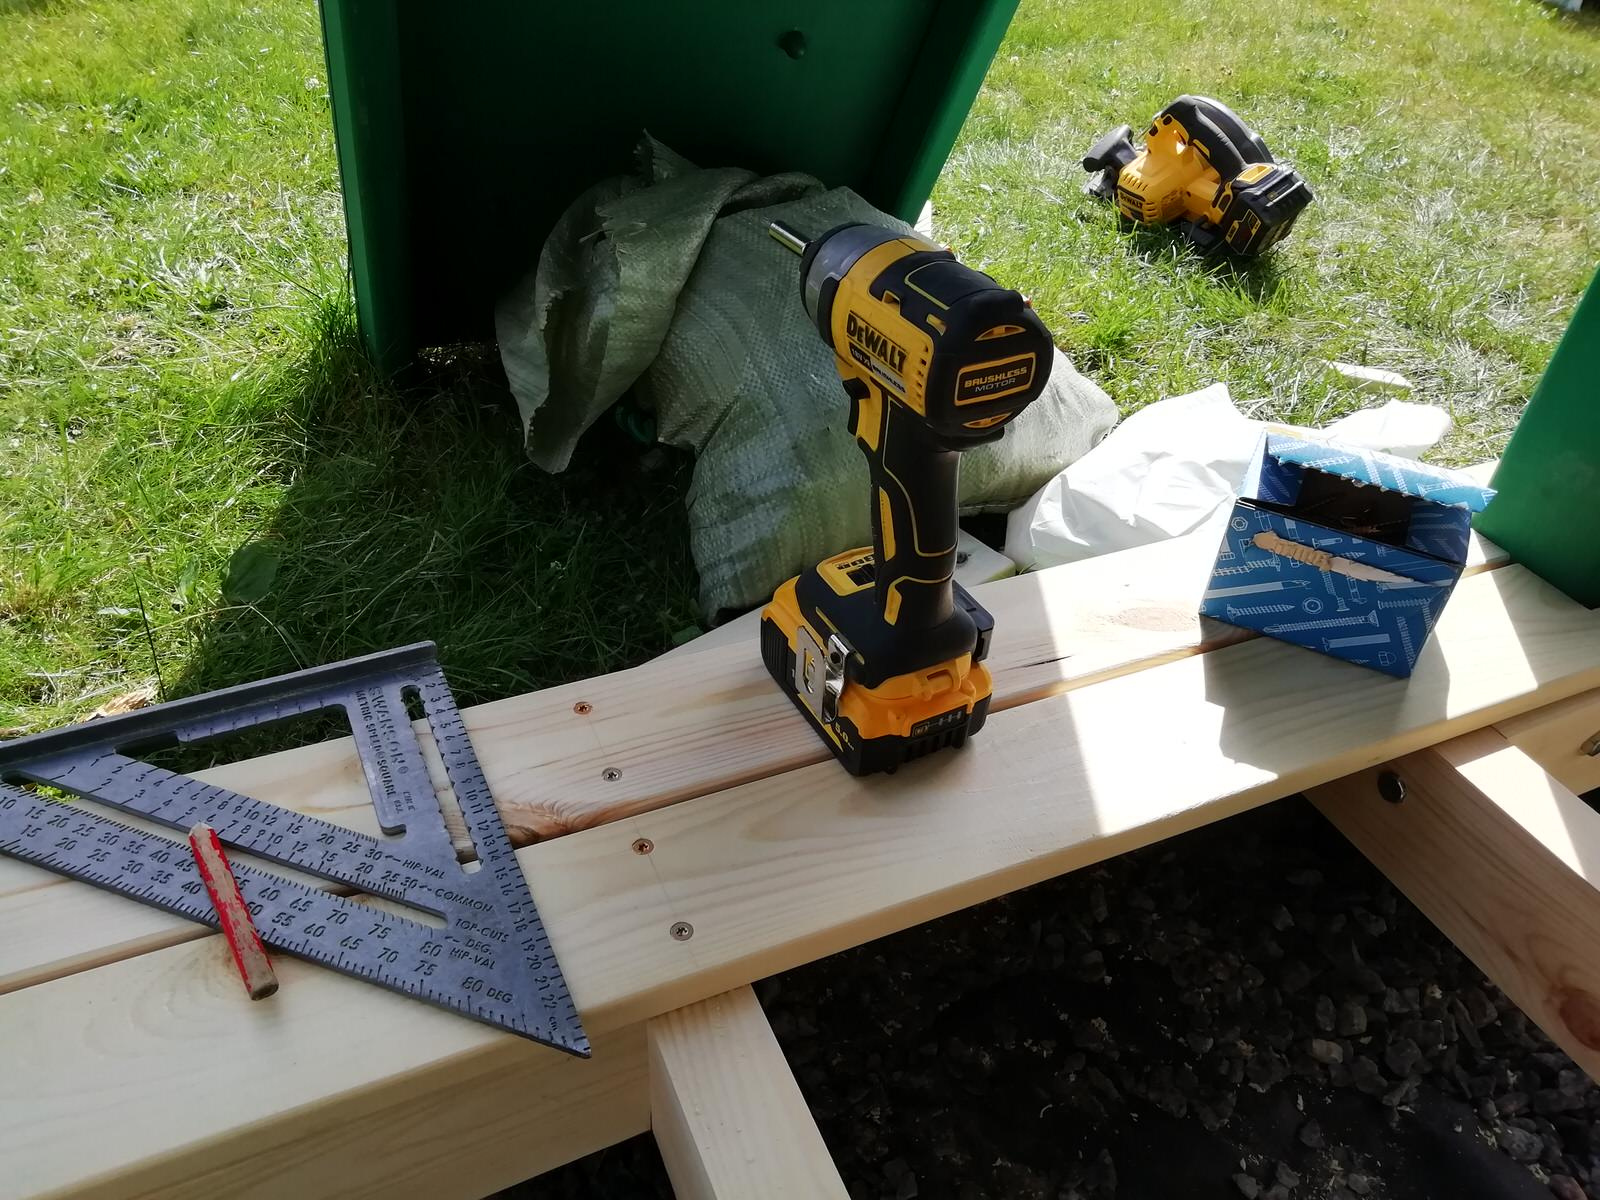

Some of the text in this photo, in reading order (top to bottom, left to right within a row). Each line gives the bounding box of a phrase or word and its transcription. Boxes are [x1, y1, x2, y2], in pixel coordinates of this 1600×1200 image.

[964, 366, 1028, 388] BRUSHLESS
[975, 377, 1016, 393] MOTOR
[440, 722, 451, 730] 5
[835, 723, 849, 743] 5.0
[465, 789, 478, 801] 10
[470, 803, 484, 814] 11
[90, 758, 100, 767] 1
[112, 766, 123, 774] 2
[135, 774, 147, 783] 3
[172, 786, 184, 795] 5
[190, 792, 200, 801] 6
[204, 796, 216, 805] 7
[217, 800, 229, 810] 8
[232, 805, 242, 814] 9
[243, 809, 260, 821] 10
[261, 814, 278, 827] 12
[286, 822, 303, 834] 15
[316, 833, 335, 846] 20
[342, 841, 361, 854] 25
[364, 848, 383, 861] 30
[402, 859, 446, 880] HIP-VAL
[477, 819, 490, 832] 12
[67, 766, 494, 912] 1 2 3 4 5 6 7 8 9 10 12 15 20 25 30 COMMON
[482, 834, 496, 848] 13
[487, 849, 501, 862] 14
[25, 806, 47, 819] 15
[47, 815, 70, 828] 20
[72, 824, 96, 837] 25
[97, 832, 120, 846] 30
[122, 841, 146, 855] 35
[149, 850, 171, 863] 40
[174, 859, 196, 873] 45
[258, 887, 281, 901] 60
[289, 898, 313, 912] 65
[326, 909, 350, 925] 70
[368, 923, 392, 939] 75
[420, 941, 443, 957] 80
[464, 938, 493, 955] DEG.
[494, 867, 508, 881] 15
[501, 883, 514, 896] 16
[20, 824, 42, 838] 15
[55, 837, 78, 851] 20
[87, 848, 111, 862] 25
[121, 860, 144, 874] 30
[151, 870, 175, 884] 35
[181, 880, 202, 895] 40
[271, 912, 296, 927] 55
[303, 923, 327, 938] 60
[339, 936, 364, 950] 65
[377, 947, 400, 963] 70
[413, 960, 438, 977] 75
[461, 976, 485, 993] 80
[486, 986, 514, 1004] DEG
[508, 902, 521, 915] 17
[455, 918, 510, 943] TOP-CUTS
[450, 948, 497, 970] HIP-VAL
[526, 954, 542, 970] 20
[534, 975, 551, 991] 21
